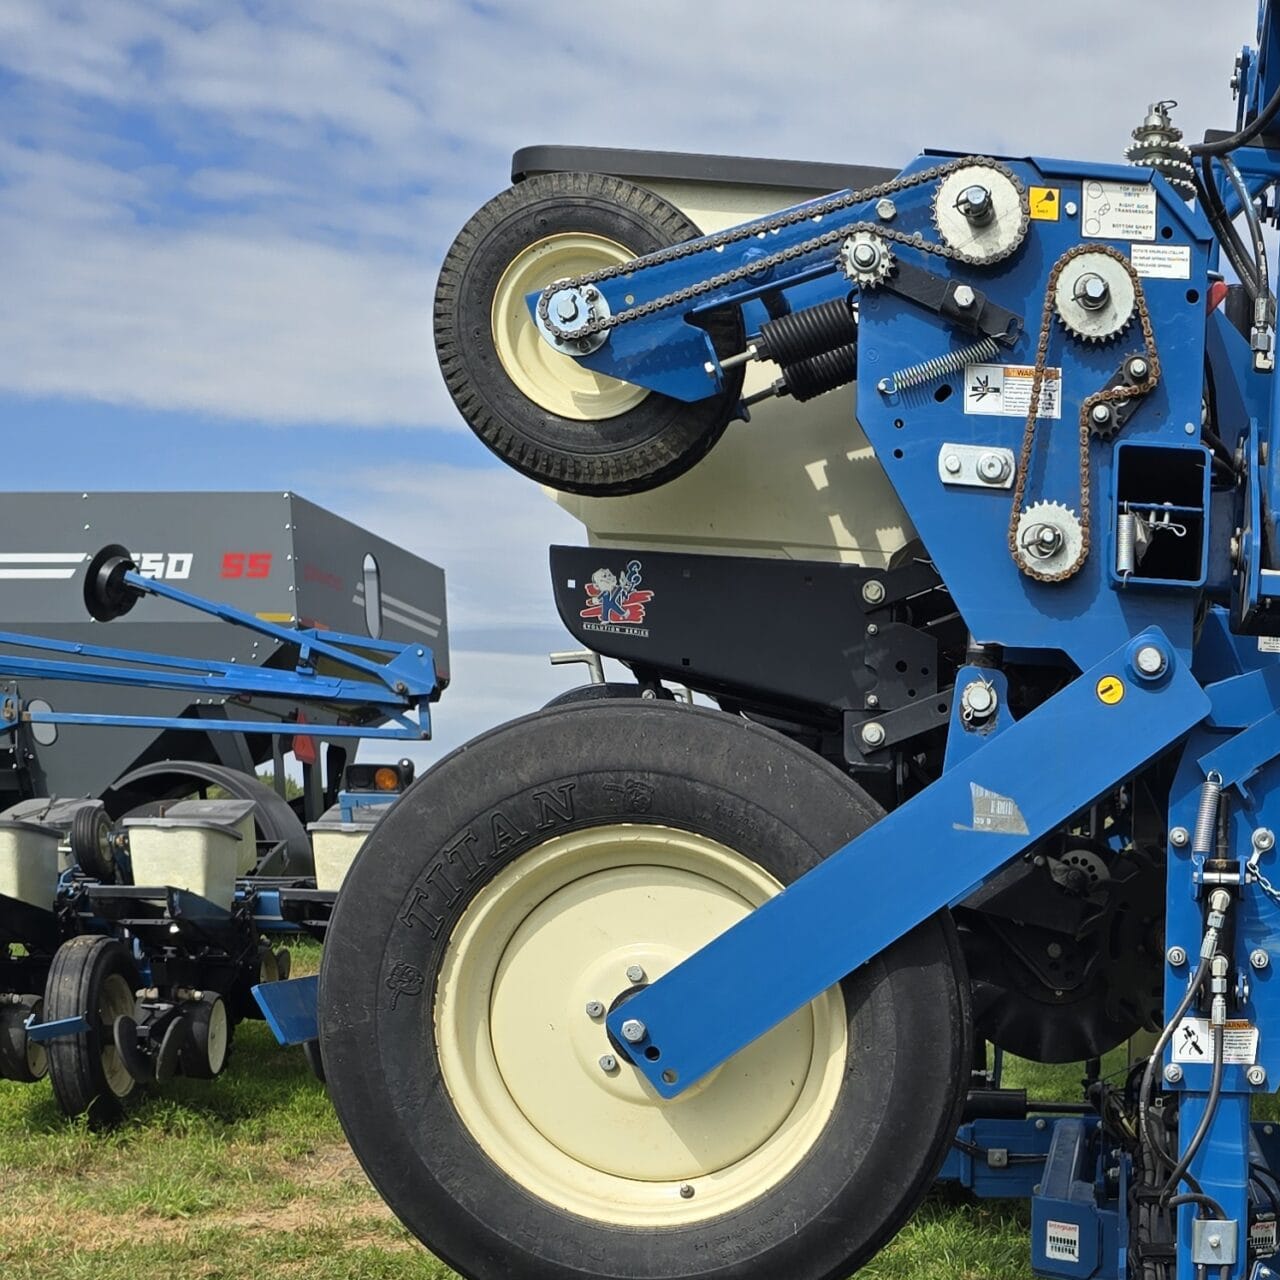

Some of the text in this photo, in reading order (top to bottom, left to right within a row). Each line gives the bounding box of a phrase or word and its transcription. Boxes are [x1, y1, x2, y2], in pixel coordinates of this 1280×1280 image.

[130, 552, 194, 580] 50
[221, 552, 273, 579] SS
[400, 782, 577, 940] TITAN
